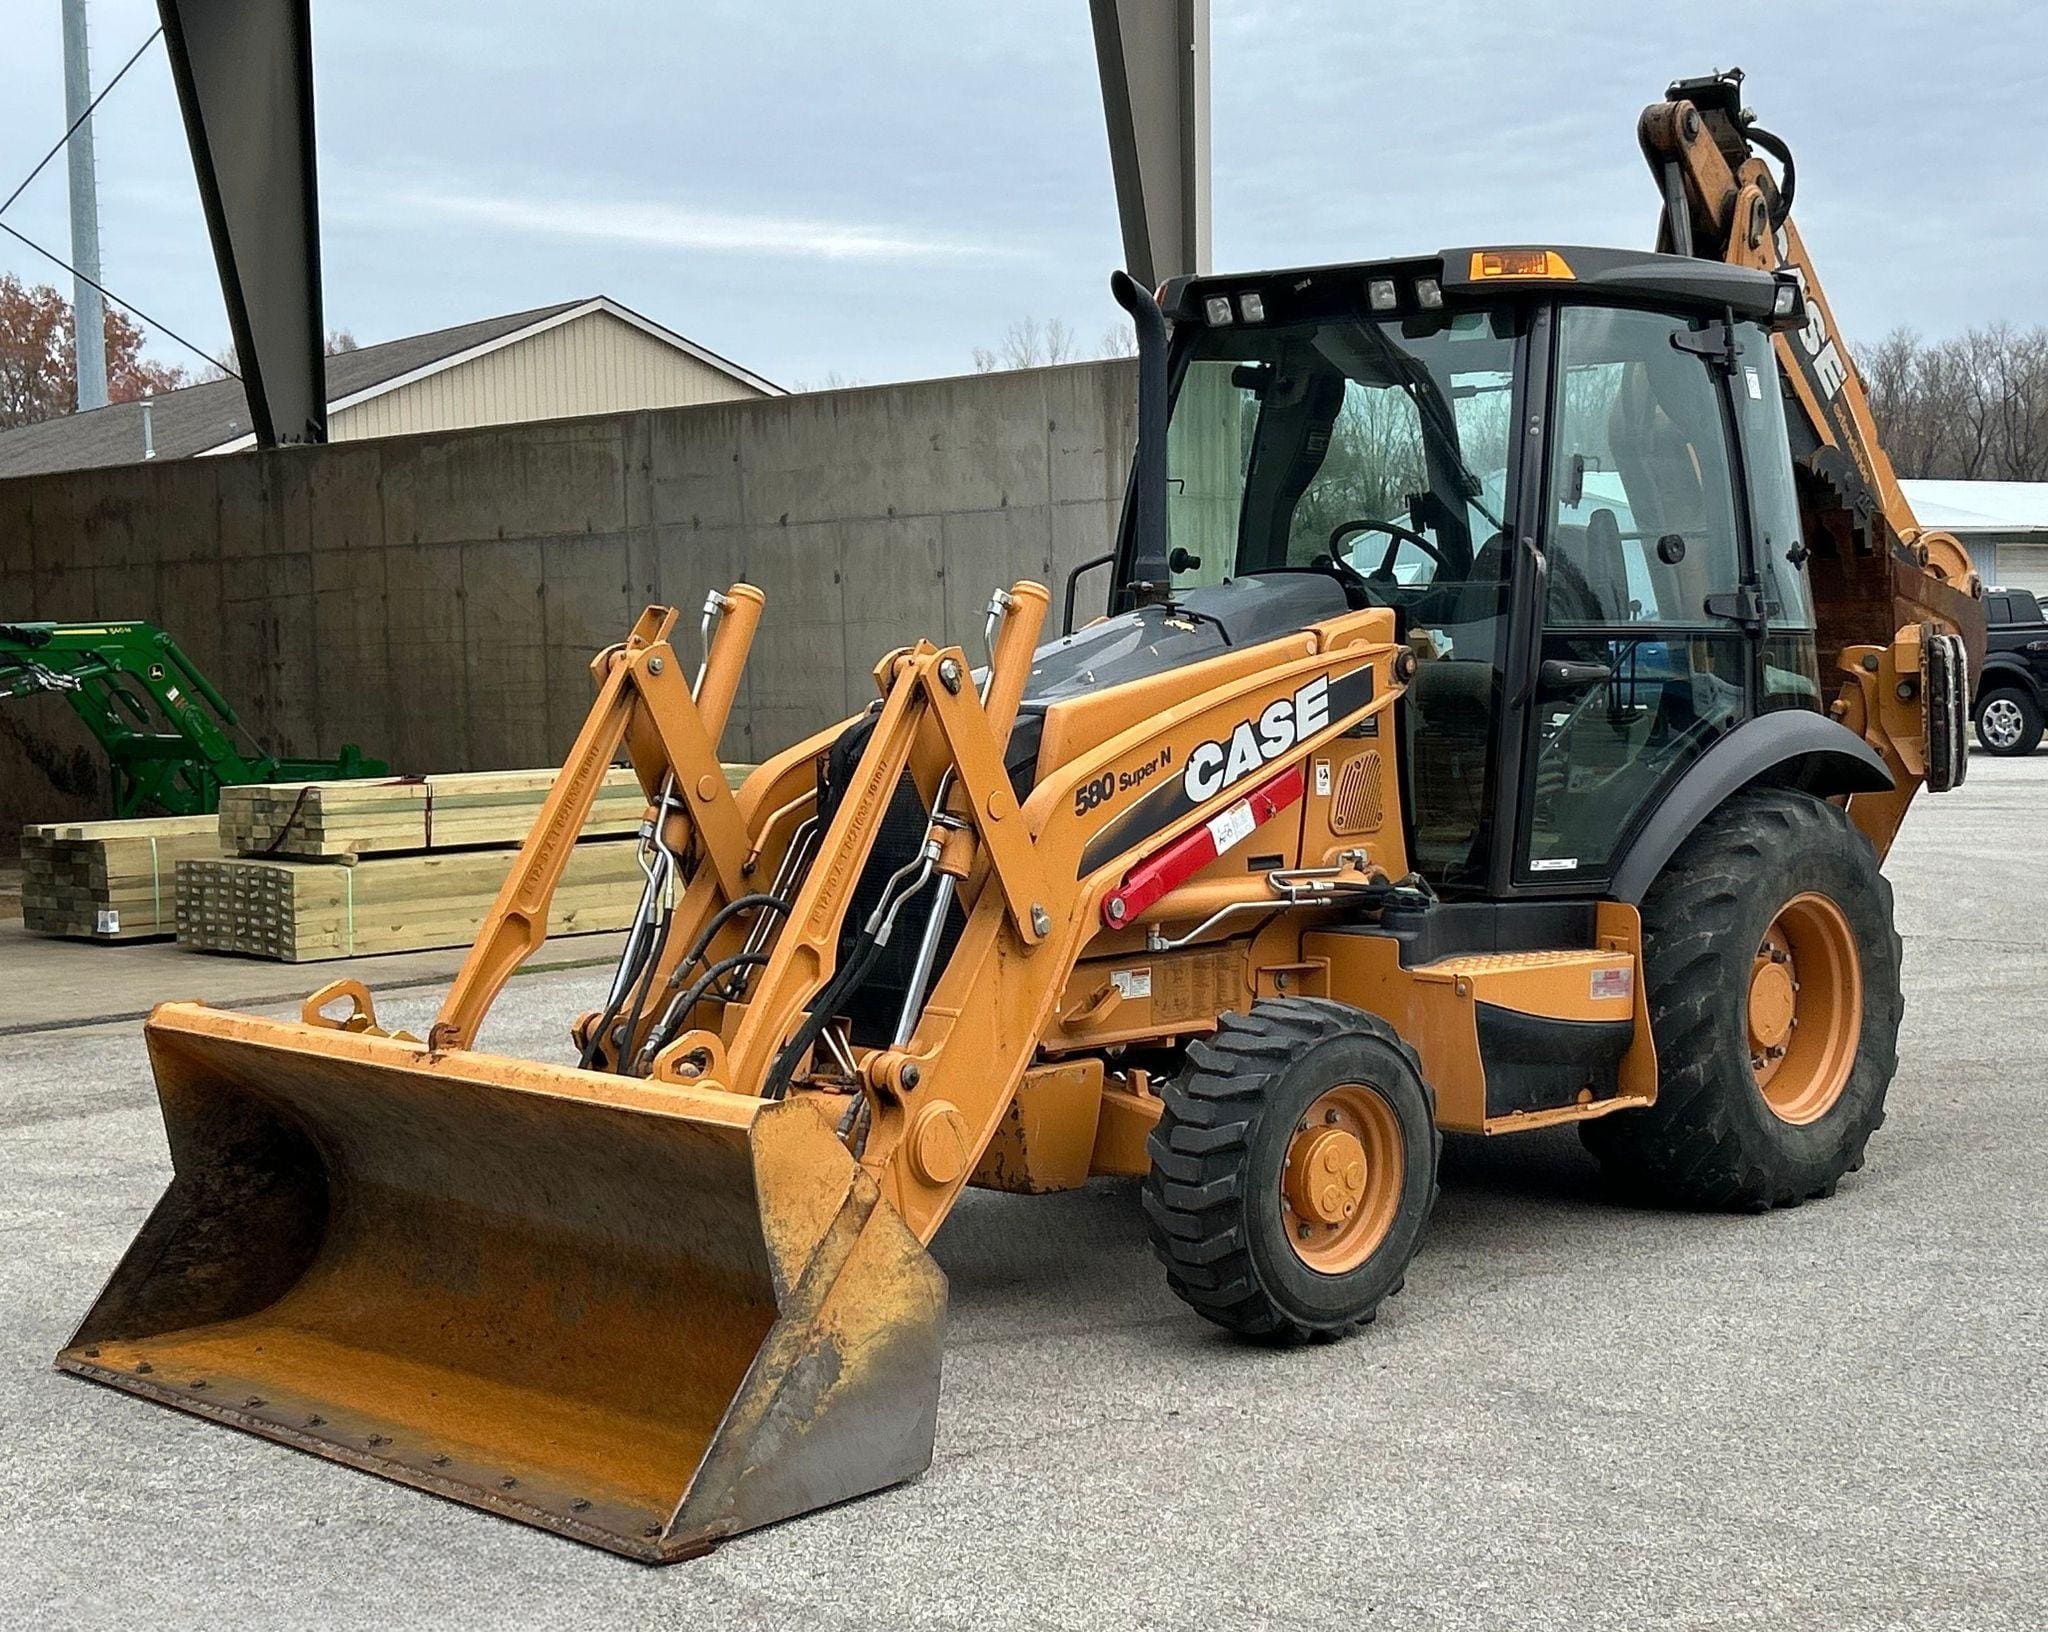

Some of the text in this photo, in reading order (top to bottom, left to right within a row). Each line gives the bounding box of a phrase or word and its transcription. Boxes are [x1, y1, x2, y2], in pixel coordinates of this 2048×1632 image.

[1075, 746, 1172, 816] 580 Super N
[1185, 674, 1329, 803] CASE
